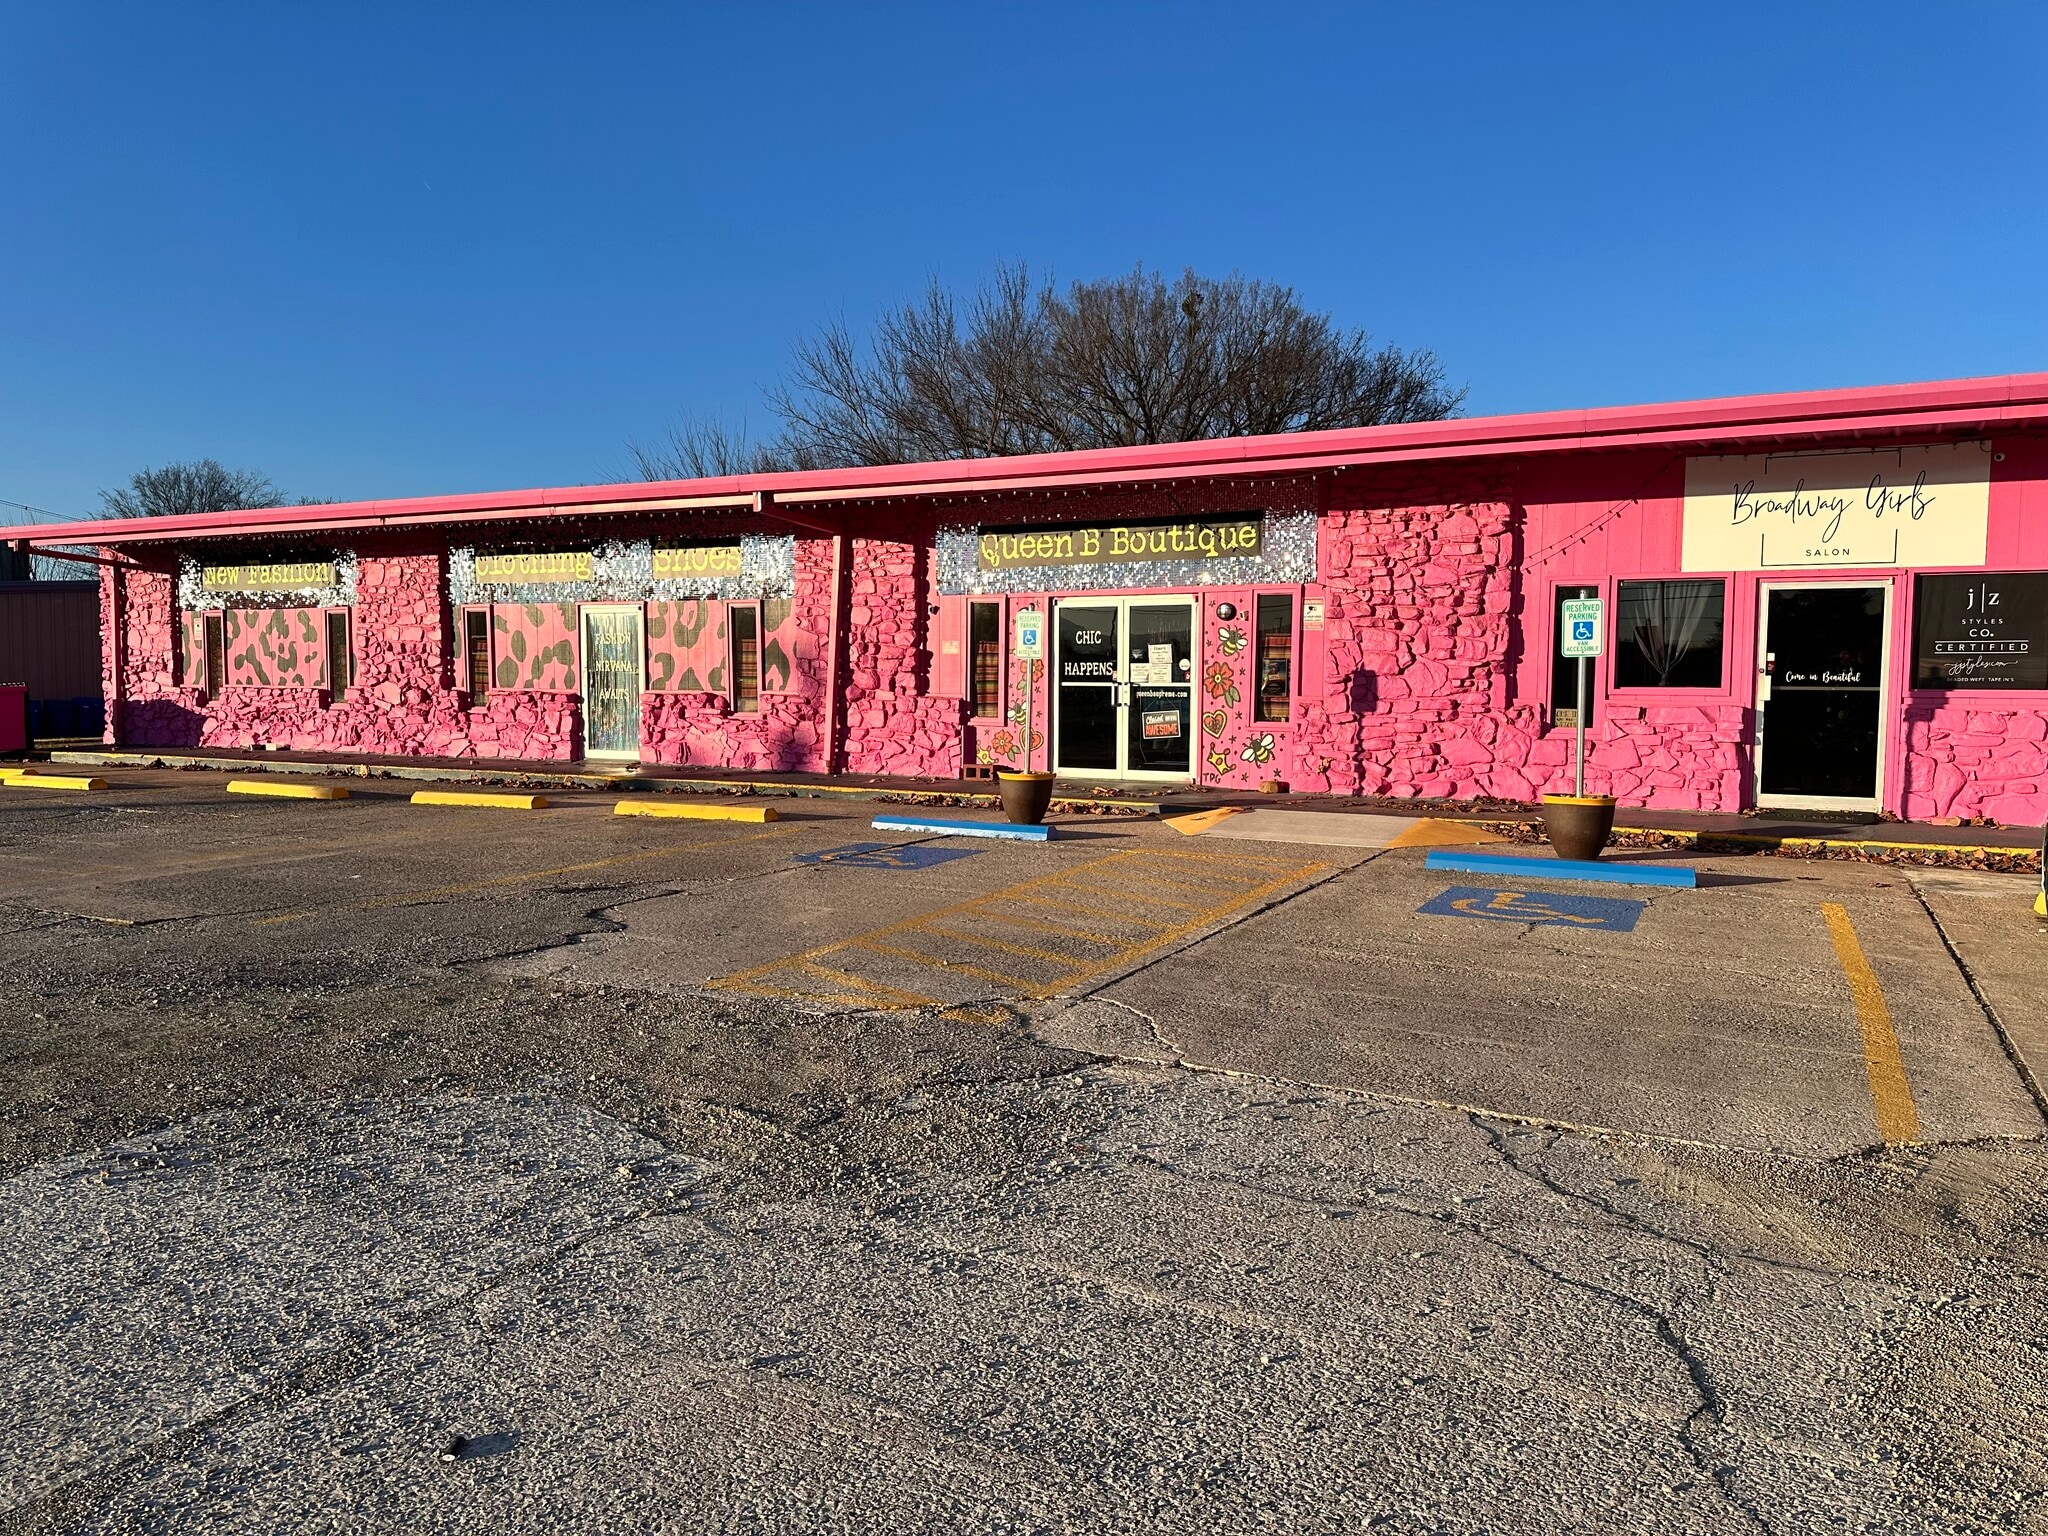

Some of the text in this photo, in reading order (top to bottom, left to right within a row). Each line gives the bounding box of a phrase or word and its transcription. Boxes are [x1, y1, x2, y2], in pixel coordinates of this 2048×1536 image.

[1731, 470, 1936, 543] Broadway Girls
[982, 523, 1257, 567] Queen B Boutique
[654, 541, 741, 573] Shoes
[1805, 548, 1850, 557] SALON
[475, 548, 592, 579] Clothing
[204, 559, 329, 586] New Fashion
[1566, 603, 1600, 612] RESERVED
[1569, 612, 1597, 621] PARKING
[595, 633, 631, 645] FASHION
[1075, 630, 1102, 645] CHIC
[1969, 628, 1994, 637] CO.
[1935, 643, 2029, 651] CERTIFIED
[595, 660, 632, 672] NIRVANA
[1064, 661, 1113, 676] HAPPENS
[1785, 670, 1805, 683] Come
[1822, 667, 1861, 683] Beautiful
[599, 688, 629, 700] AWAITS
[1145, 723, 1178, 736] AWESOME
